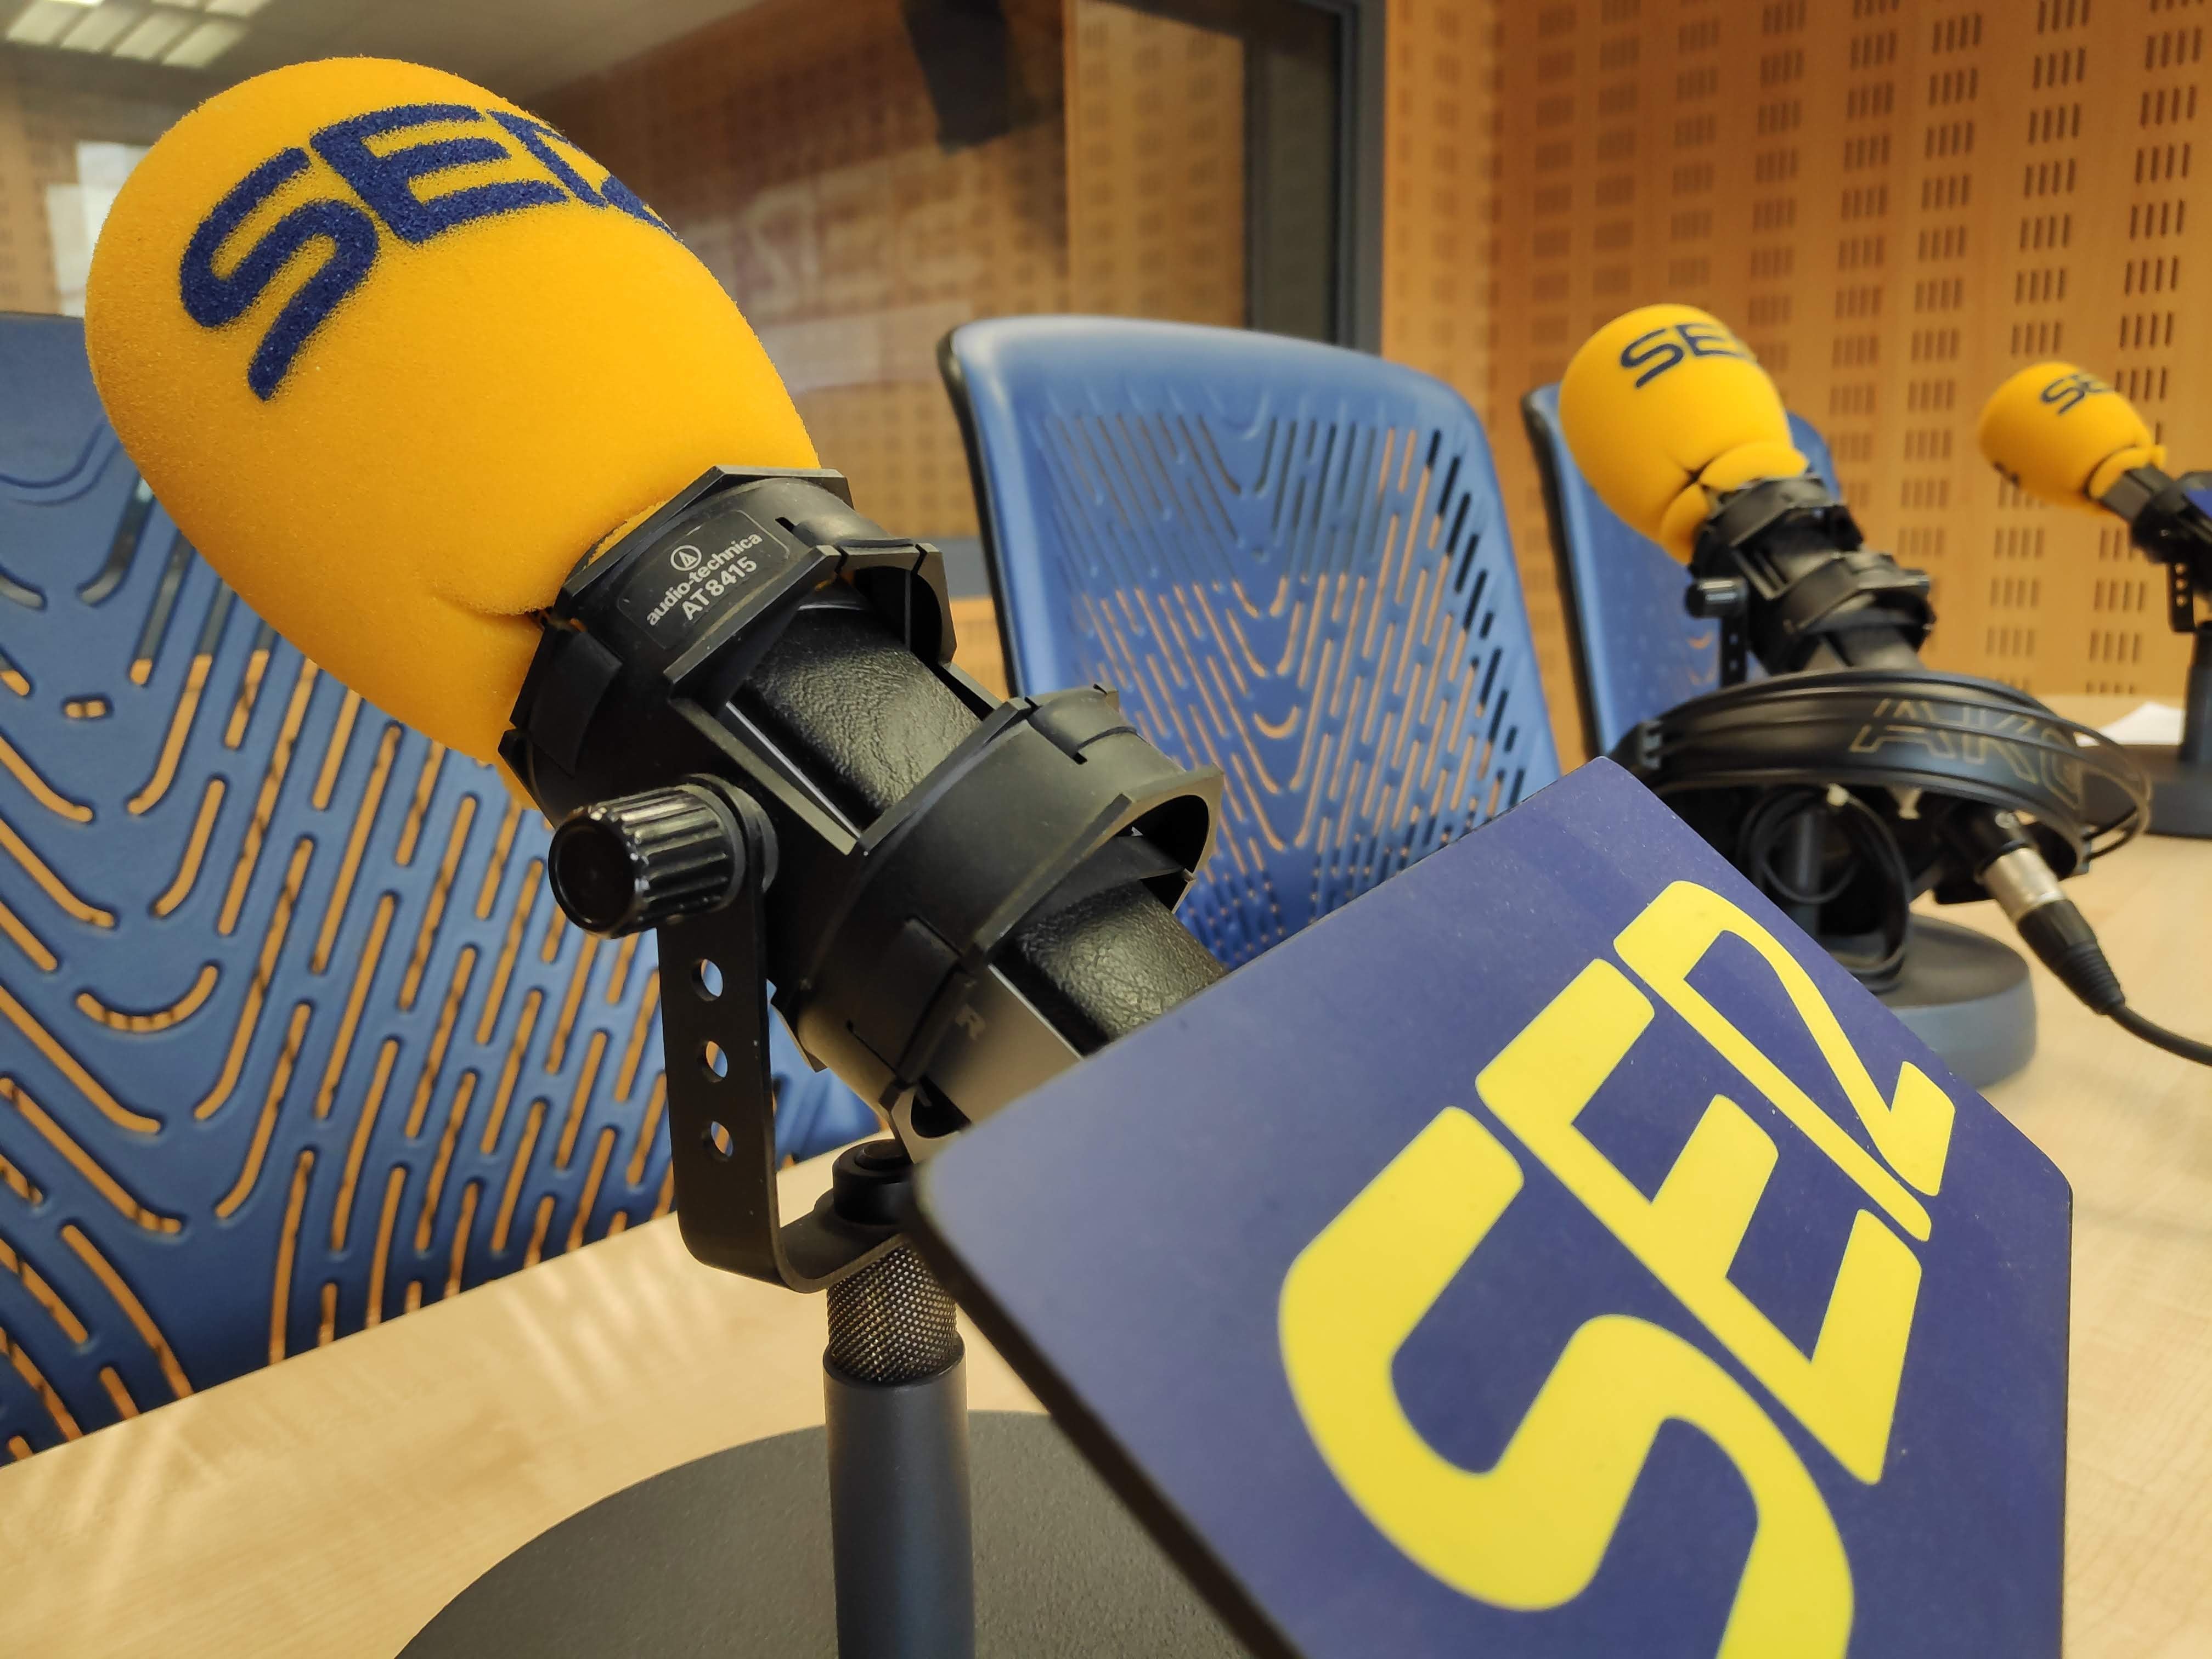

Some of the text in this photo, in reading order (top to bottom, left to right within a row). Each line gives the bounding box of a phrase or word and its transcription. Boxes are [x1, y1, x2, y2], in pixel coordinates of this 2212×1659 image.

[647, 534, 763, 625] audio-technica
[682, 556, 757, 620] AT8415
[1278, 881, 1955, 1659] SER
